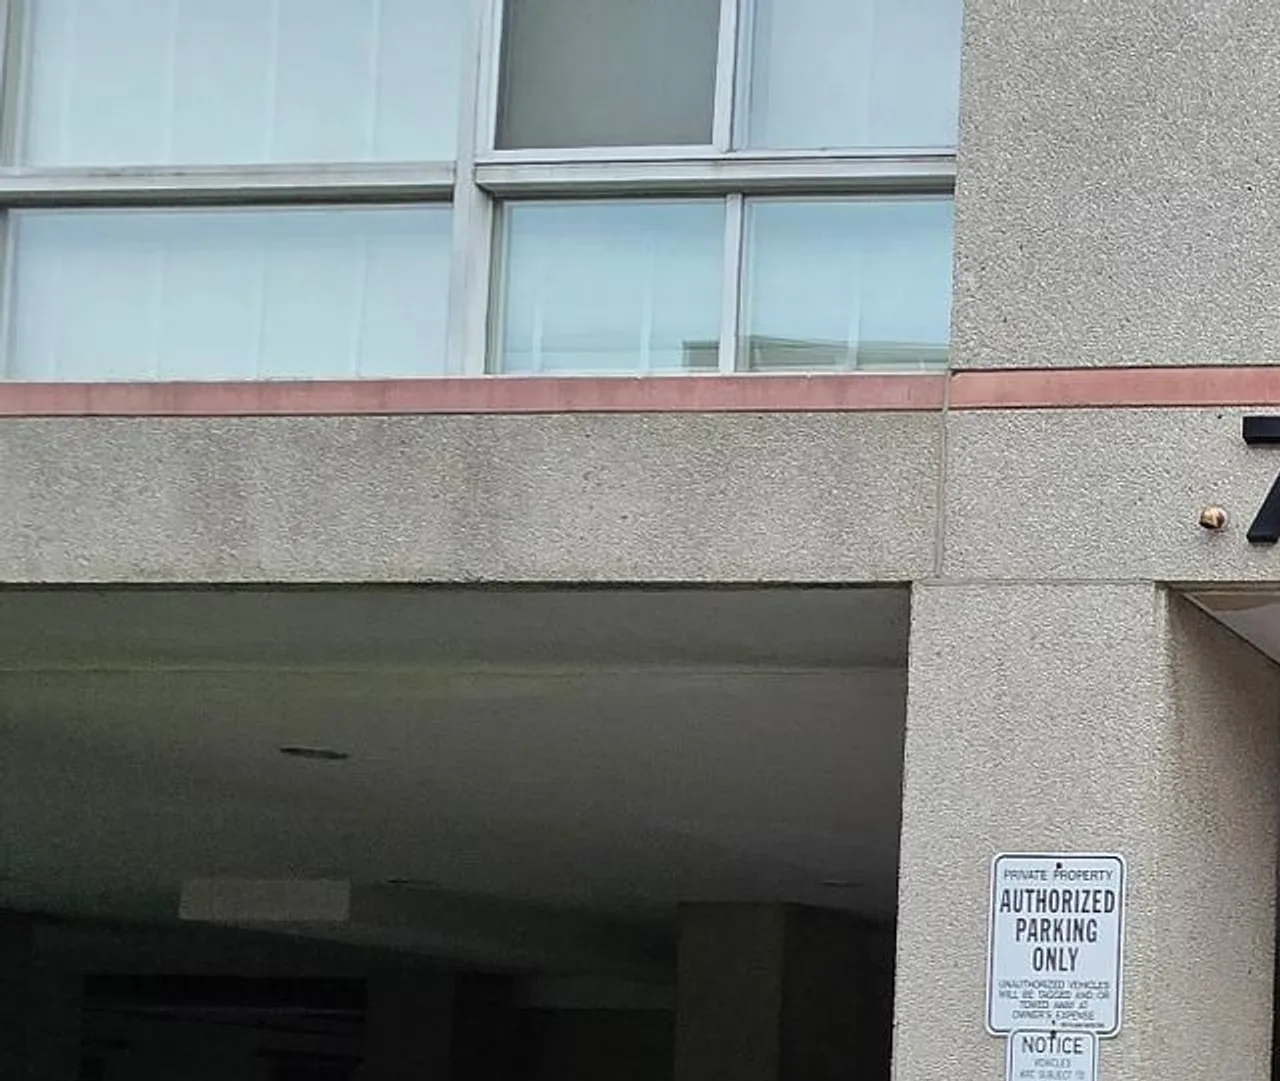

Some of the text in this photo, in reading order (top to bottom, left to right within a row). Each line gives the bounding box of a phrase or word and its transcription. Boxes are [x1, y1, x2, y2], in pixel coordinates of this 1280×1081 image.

[1004, 870, 1113, 881] PRIVATE PROPERTY
[1000, 889, 1116, 913] AUTHORIZED
[1015, 918, 1098, 943] PARKING
[1032, 947, 1079, 971] ONLY
[1022, 1036, 1083, 1054] NOTICE
